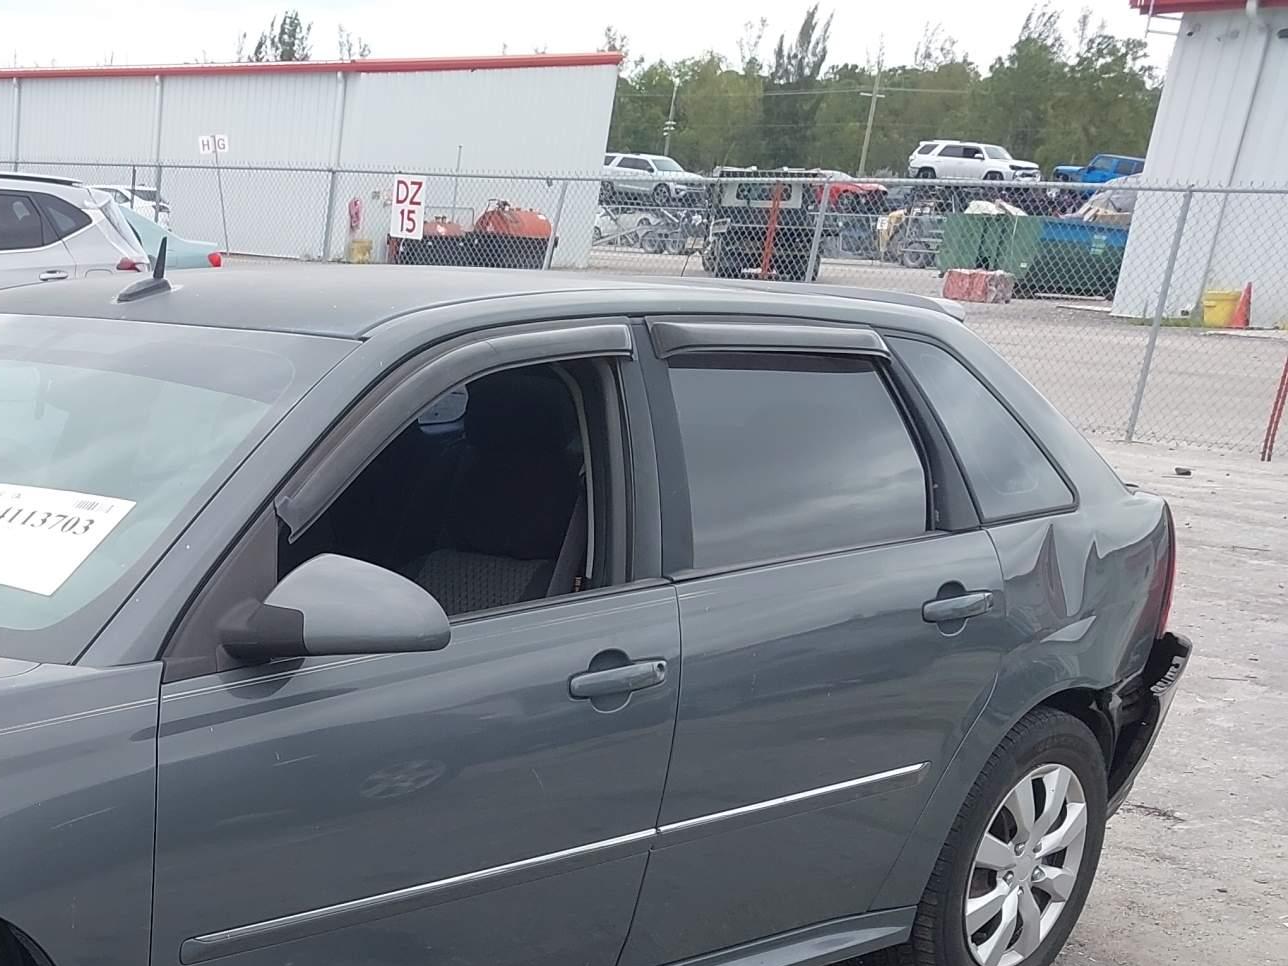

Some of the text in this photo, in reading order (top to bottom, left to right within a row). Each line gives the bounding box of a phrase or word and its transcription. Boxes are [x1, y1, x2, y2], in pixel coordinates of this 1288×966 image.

[201, 139, 210, 152] H
[217, 138, 226, 150] G
[395, 180, 424, 206] DZ
[399, 208, 417, 234] 15
